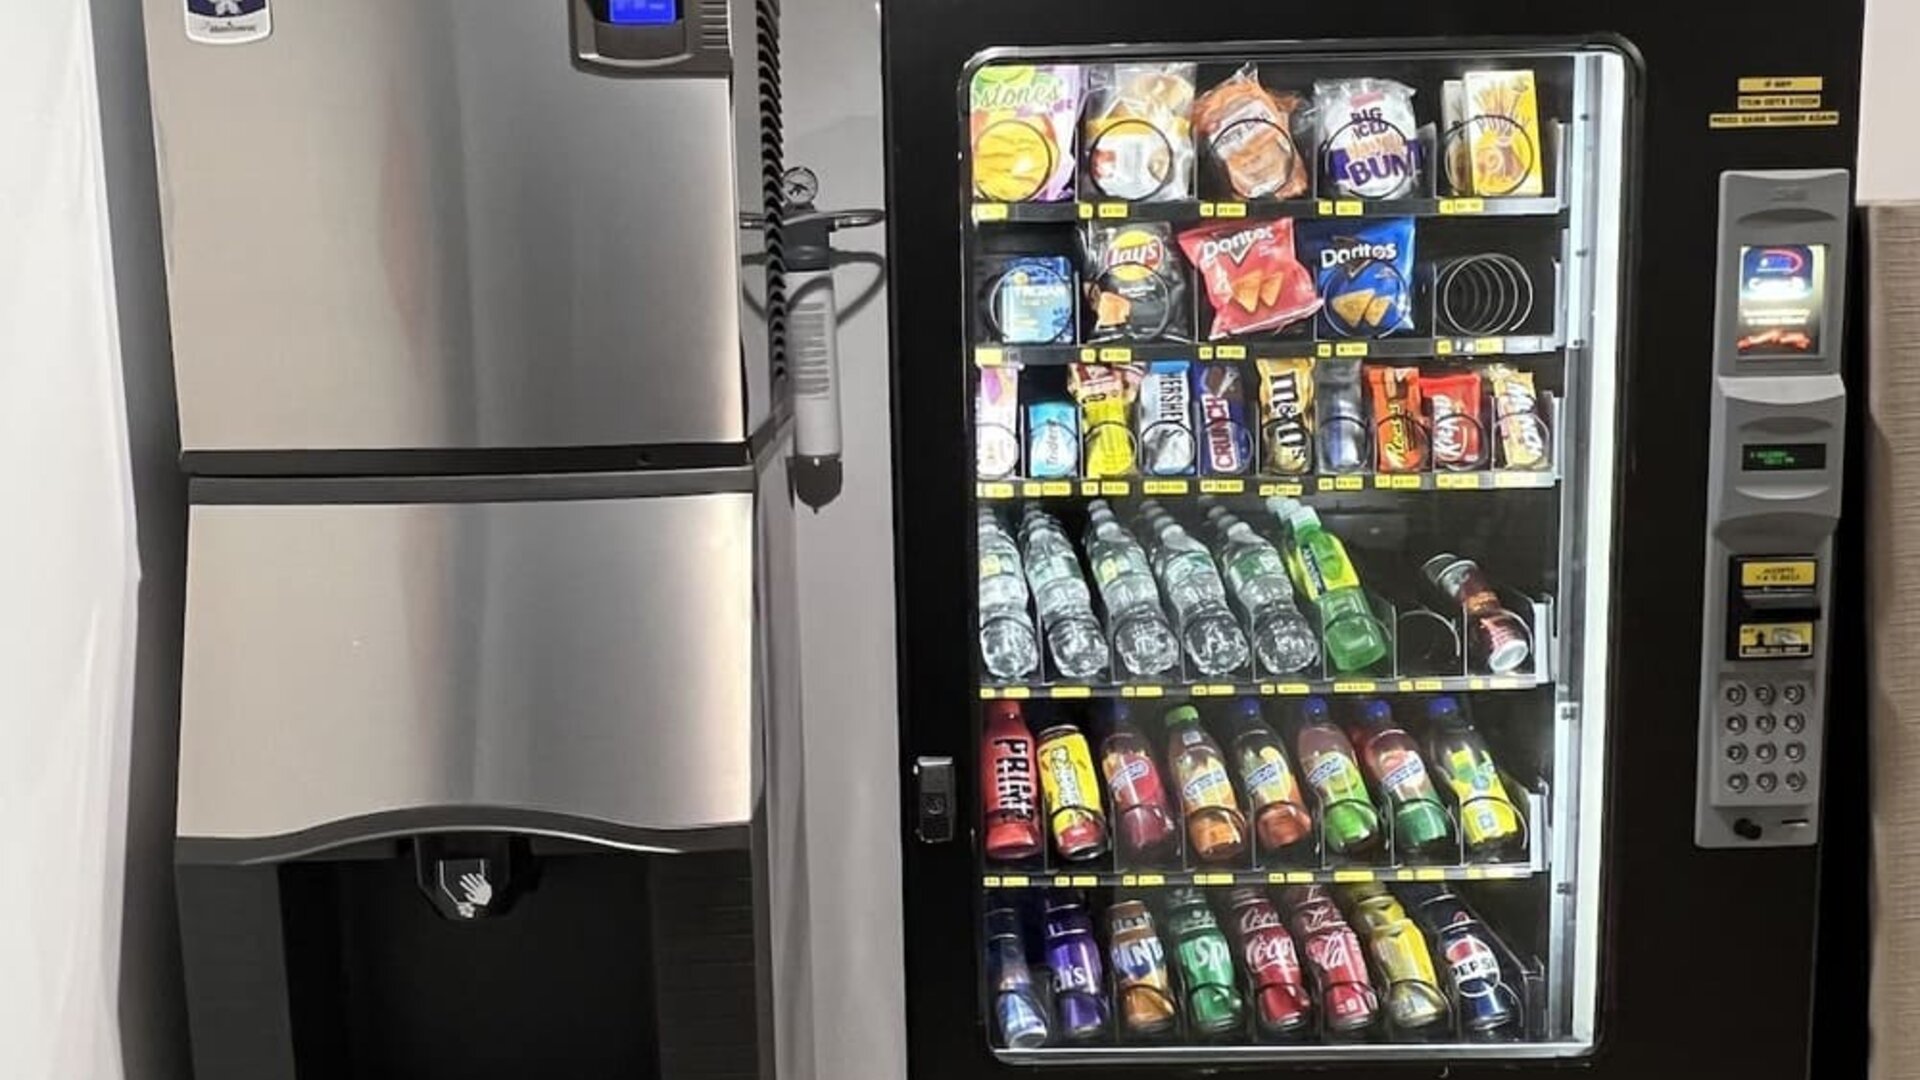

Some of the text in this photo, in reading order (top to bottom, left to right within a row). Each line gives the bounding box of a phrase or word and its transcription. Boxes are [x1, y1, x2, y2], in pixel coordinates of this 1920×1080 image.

[1351, 107, 1383, 125] BIG
[1352, 120, 1389, 140] ICED
[1320, 242, 1398, 269] Doritos
[1203, 397, 1236, 469] CRUNCH
